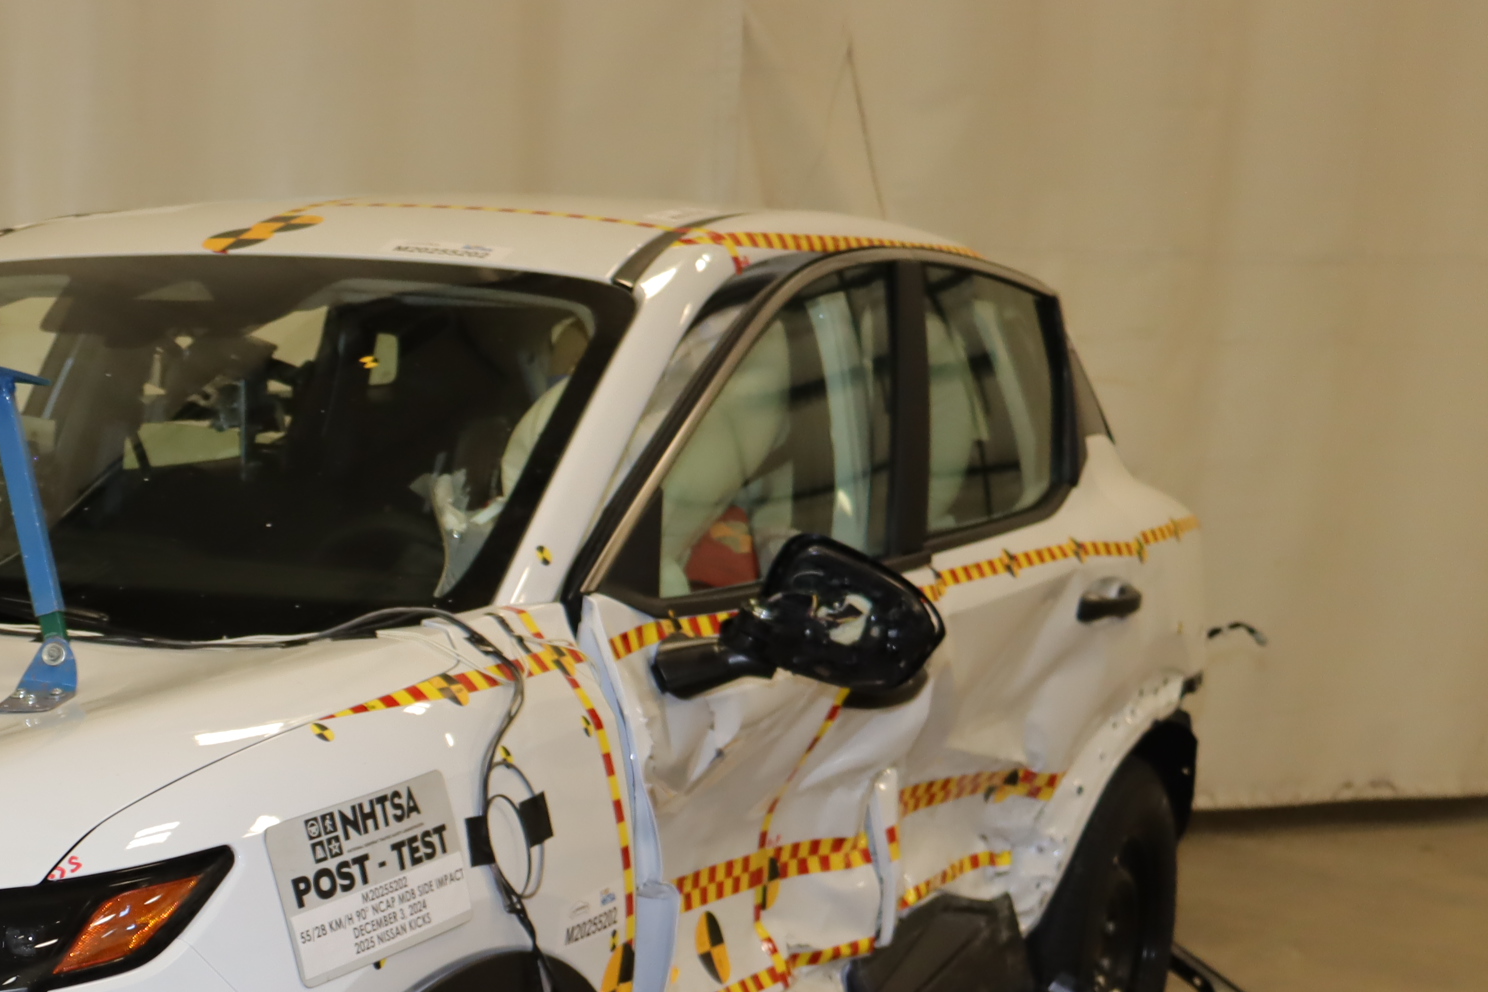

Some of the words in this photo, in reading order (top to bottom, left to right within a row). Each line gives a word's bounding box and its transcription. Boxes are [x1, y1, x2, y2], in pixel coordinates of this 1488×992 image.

[338, 786, 421, 841] NHTSA
[291, 853, 370, 909] POST
[390, 824, 447, 871] TEST
[361, 876, 408, 904] M20255202
[300, 924, 328, 944] 55/28
[328, 913, 354, 933] KM/H
[371, 895, 396, 916] NCAP
[398, 888, 416, 905] MDB
[417, 880, 434, 897] SIDE
[436, 868, 464, 889] IMPACT
[353, 911, 398, 939] DECEMBER
[408, 899, 427, 916] 2024
[354, 936, 376, 955] 2025
[376, 923, 407, 945] NISSAN
[408, 912, 432, 931] KICKS
